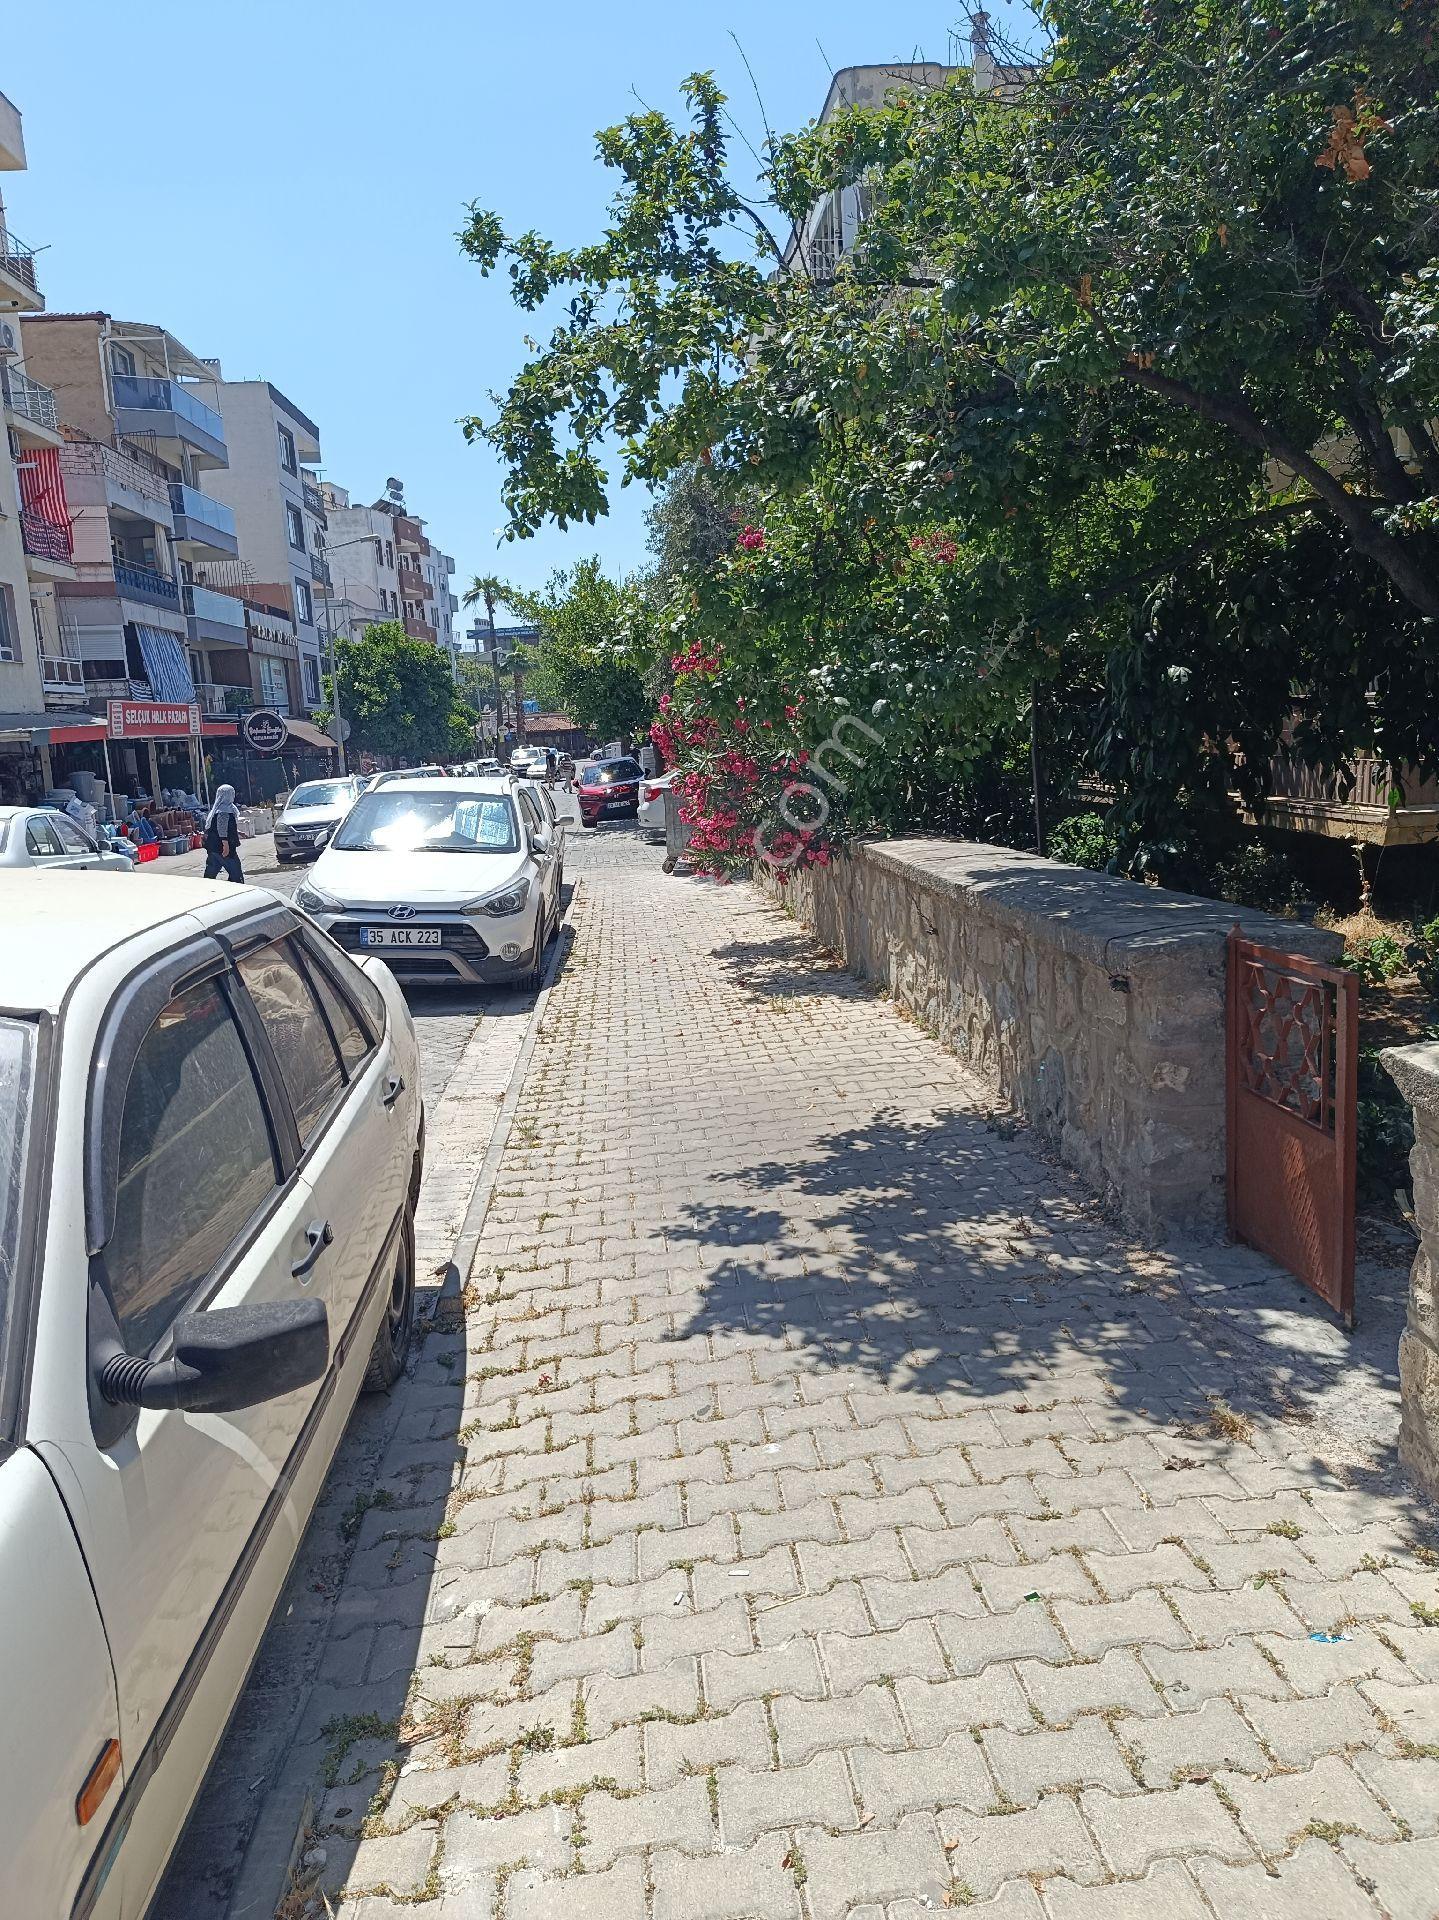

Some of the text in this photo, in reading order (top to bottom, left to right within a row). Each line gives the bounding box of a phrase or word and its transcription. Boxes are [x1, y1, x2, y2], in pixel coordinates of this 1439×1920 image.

[125, 709, 150, 727] SELÇUK
[151, 710, 167, 724] HALK
[369, 930, 439, 944] 35 ACK 223
